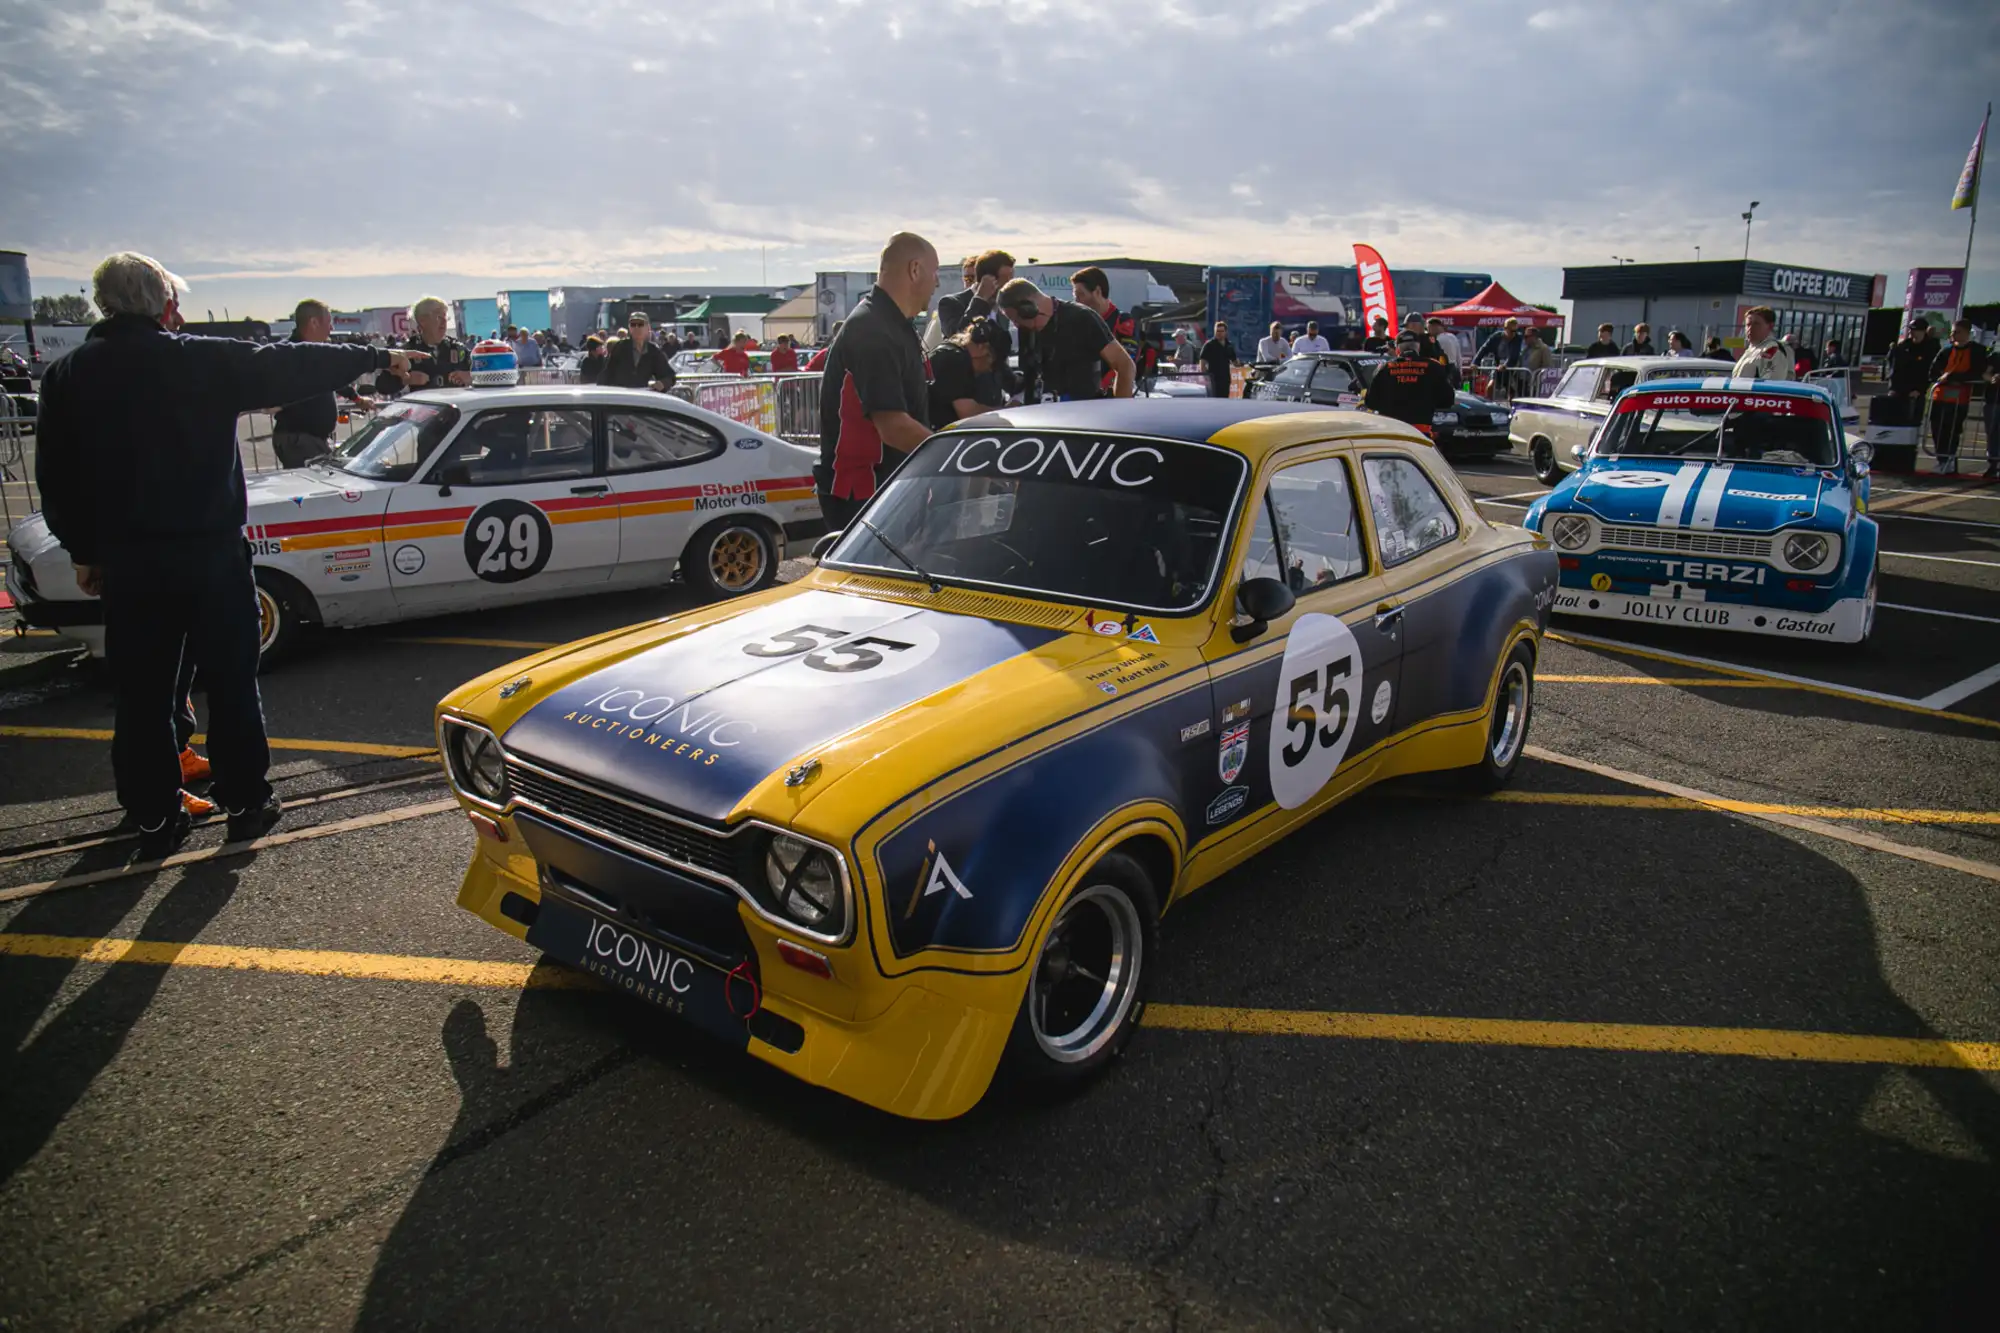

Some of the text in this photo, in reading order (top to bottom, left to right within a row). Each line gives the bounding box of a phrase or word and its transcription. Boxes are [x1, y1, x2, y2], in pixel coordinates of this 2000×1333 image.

[1773, 269, 1851, 298] COFFEE BOX
[1653, 395, 1792, 410] auto moto sport
[939, 437, 1164, 486] ICONIC
[702, 480, 755, 497] Shell
[1731, 490, 1801, 501] Castrol
[695, 493, 766, 511] Motor Oils
[476, 513, 540, 574] 29
[1660, 559, 1766, 585] TERZI
[1554, 593, 1581, 608] trol
[1622, 600, 1730, 625] JOLLY CLUB
[1099, 622, 1117, 634] E
[1776, 617, 1836, 635] Castrol
[742, 624, 917, 673] 55
[1086, 651, 1157, 681] Harry Whale
[1116, 659, 1171, 685] Matt Neal
[584, 685, 758, 746] ICONIC
[1282, 654, 1352, 768] 55
[563, 711, 720, 766] AUCTIONEERS
[1209, 795, 1244, 819] LEGENDS
[586, 918, 695, 993] ICONIC
[580, 955, 685, 1014] AUCTIONEERS
